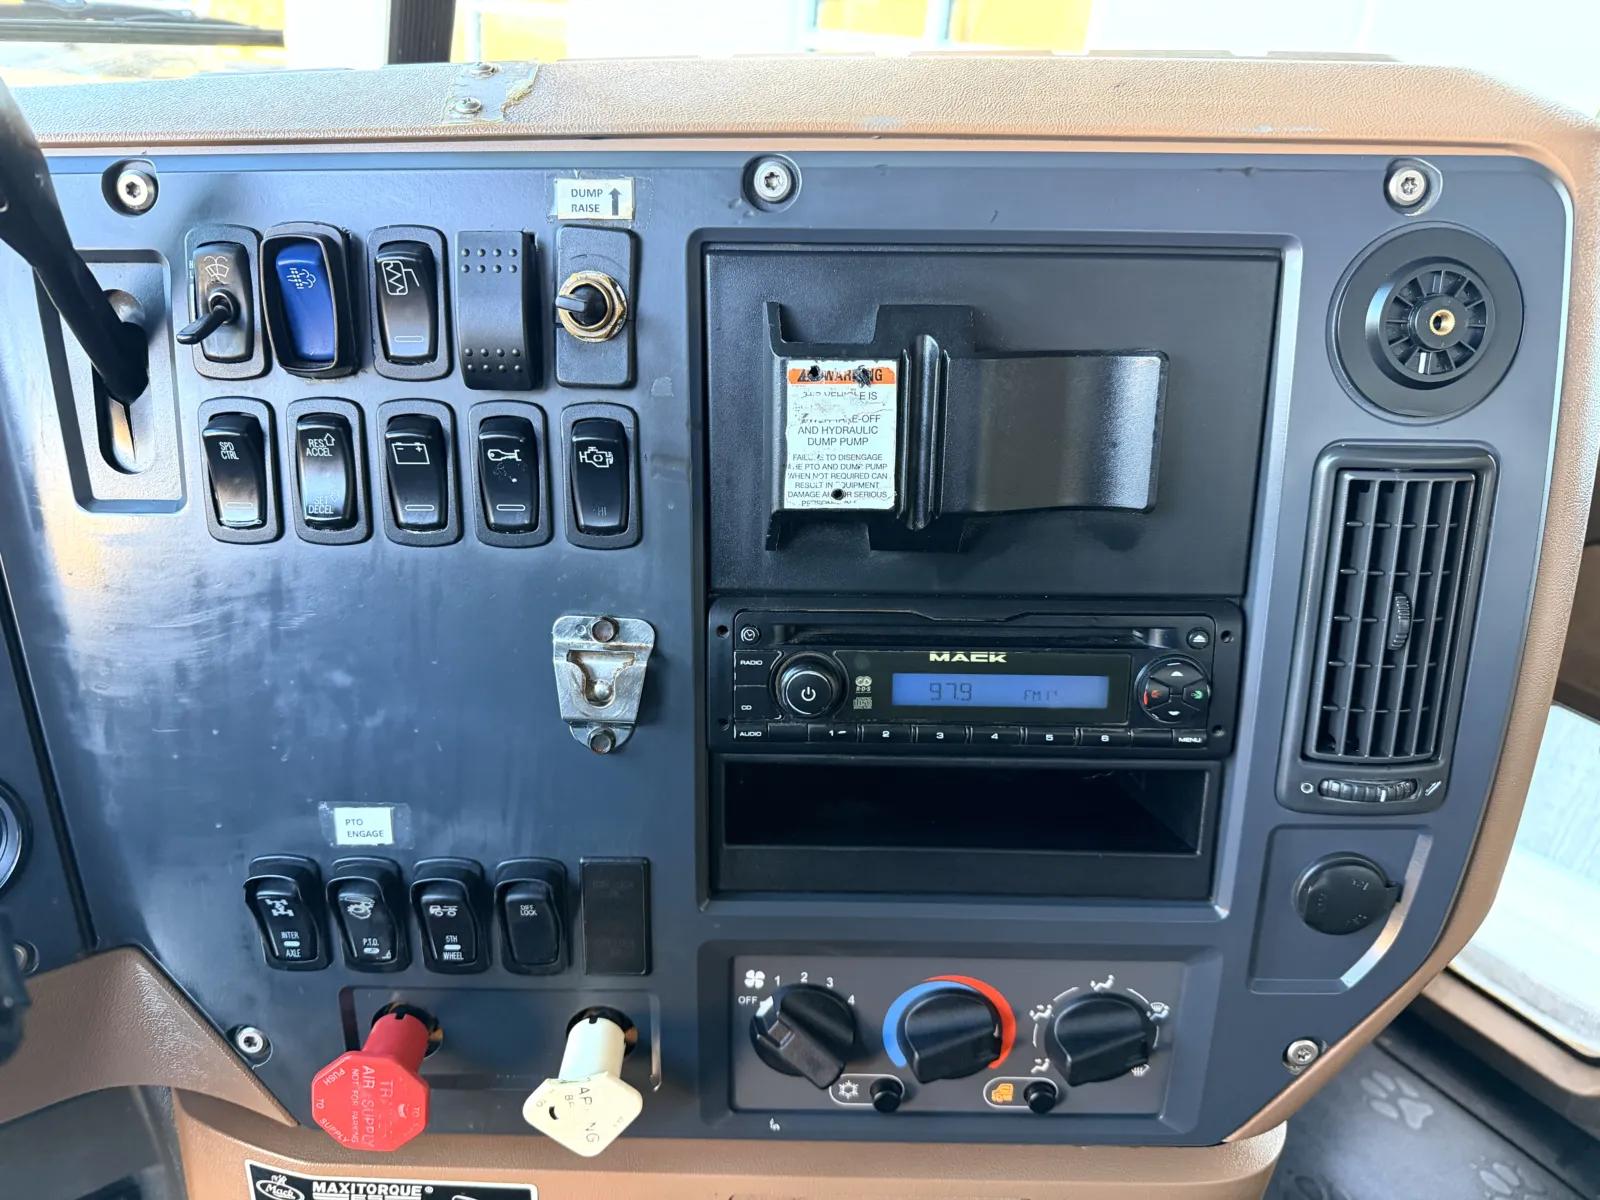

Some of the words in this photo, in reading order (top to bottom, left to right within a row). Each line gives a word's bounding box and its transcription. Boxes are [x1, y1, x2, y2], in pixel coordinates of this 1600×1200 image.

[571, 188, 603, 198] DUMP
[571, 203, 601, 213] RAISE
[868, 391, 878, 400] IS
[798, 426, 819, 435] AND
[821, 426, 879, 435] HYDRAULIC
[219, 441, 235, 451] SPD
[807, 437, 837, 446] DUMP
[839, 437, 869, 446] PUMP
[220, 450, 240, 460] CTRL
[305, 447, 333, 457] ACCEL
[826, 453, 837, 461] TO
[838, 453, 883, 461] DISENGAGE
[804, 463, 821, 471] PTO
[822, 463, 839, 471] AND
[865, 463, 888, 471] PUMP
[787, 472, 811, 480] WHEN
[812, 472, 829, 480] NOT
[830, 472, 870, 480] REQUIRED
[871, 472, 888, 480] CAN
[853, 490, 888, 498] SERIOUS
[308, 504, 334, 515] DECEL
[929, 651, 1007, 663] MACK
[882, 730, 890, 738] 2
[1101, 734, 1109, 742] 6
[345, 818, 363, 826] PTO
[347, 830, 385, 838] ENGAGE
[445, 935, 458, 943] 5TH
[285, 949, 301, 958] AXLE
[443, 951, 464, 960] WHEEL
[774, 975, 781, 986] 1
[800, 971, 808, 983] 2
[826, 977, 834, 988] 3
[738, 996, 758, 1005] OFF
[847, 994, 856, 1006] 4
[323, 1067, 346, 1086] PUSH
[351, 1068, 360, 1085] NOT
[361, 1065, 376, 1089] AIR
[351, 1089, 360, 1105] FOR
[315, 1098, 325, 1109] TO
[320, 1118, 350, 1142] SUPPLY
[264, 1183, 297, 1199] Mack
[312, 1181, 423, 1196] MAXITORQUE
